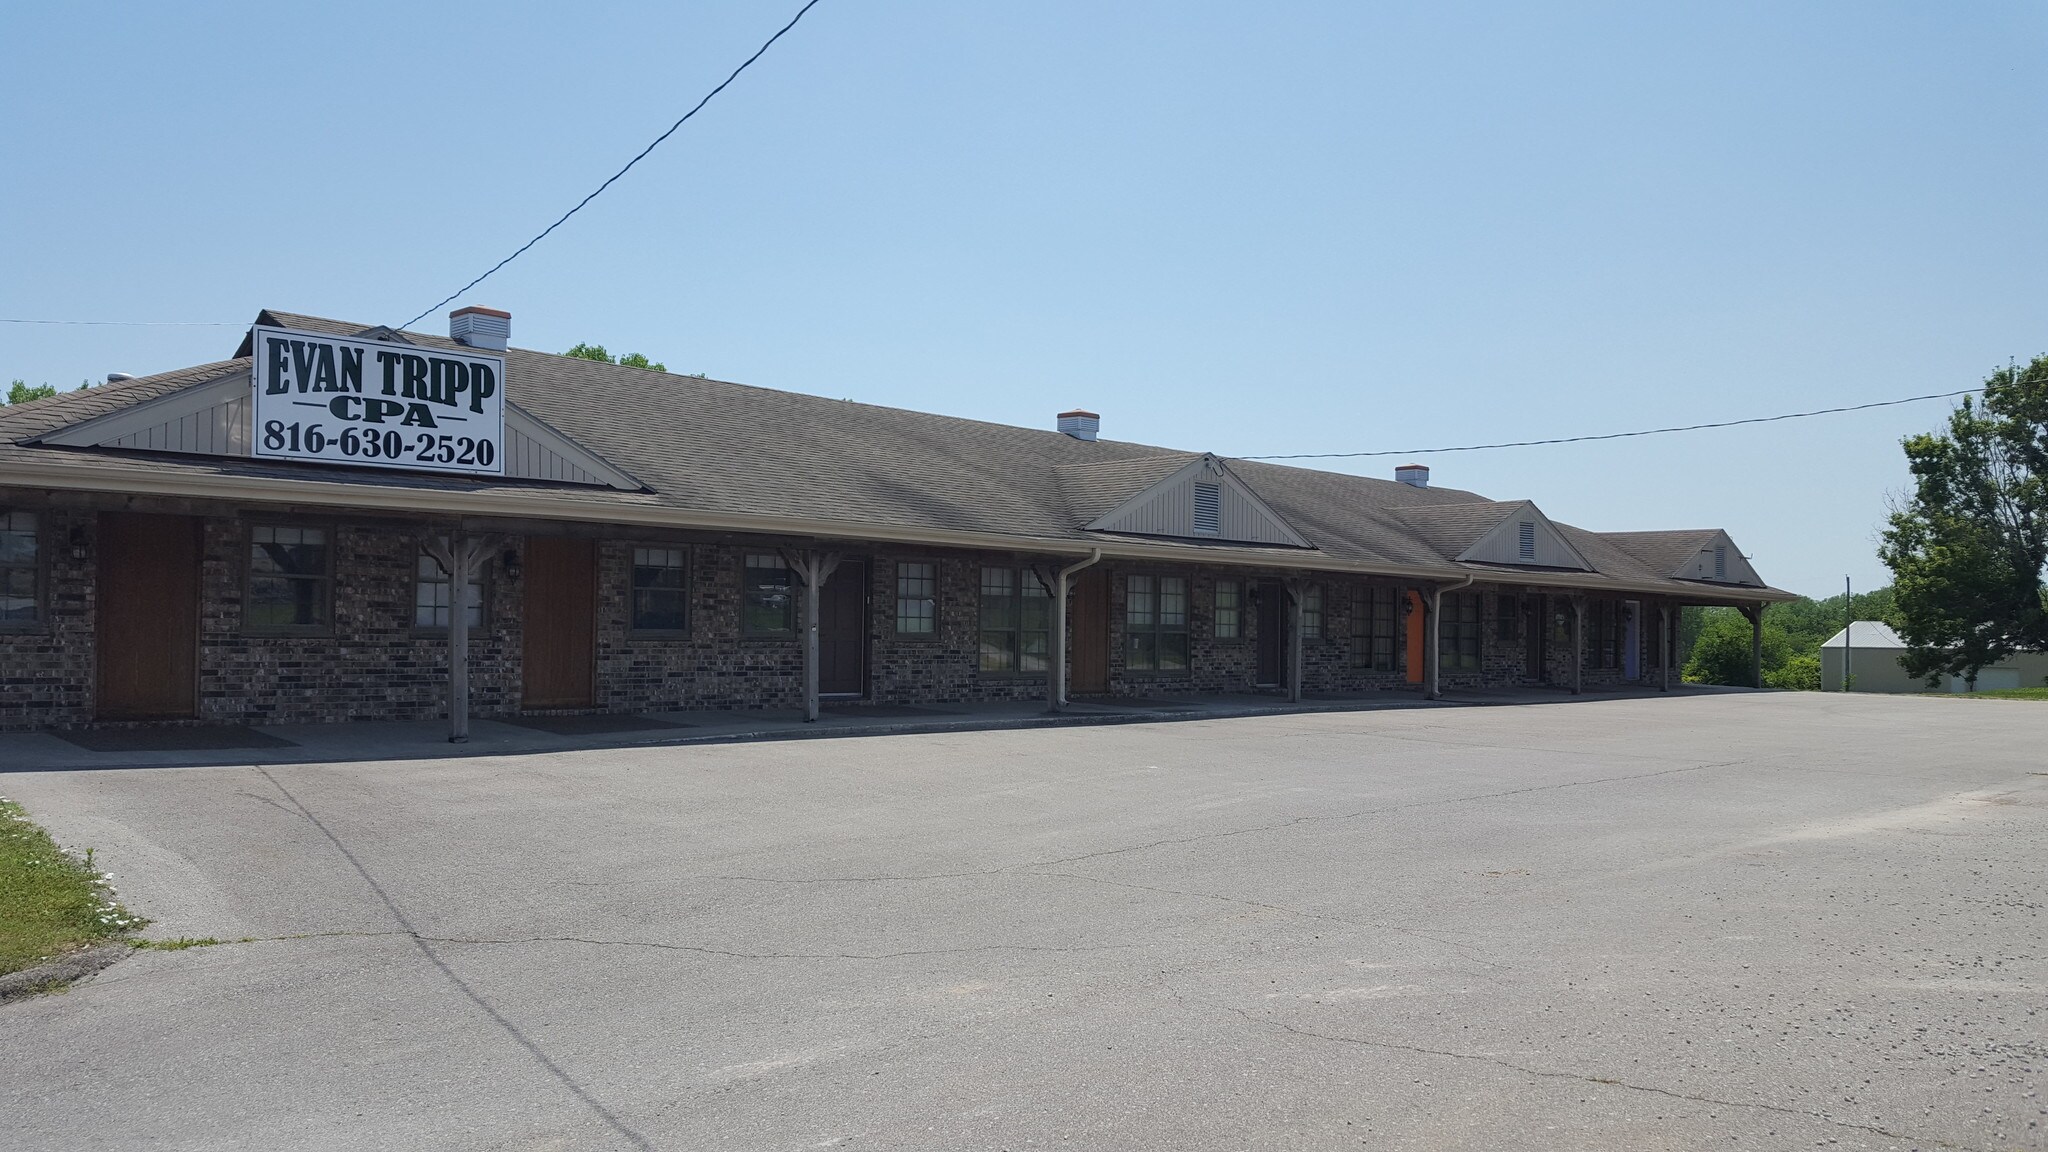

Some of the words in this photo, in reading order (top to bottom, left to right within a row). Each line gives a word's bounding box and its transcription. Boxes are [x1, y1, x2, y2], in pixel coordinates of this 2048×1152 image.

[266, 337, 364, 395] EVAN
[377, 350, 496, 414] TRIPP
[329, 395, 438, 428] CPA
[263, 420, 495, 466] 816-630-2520
